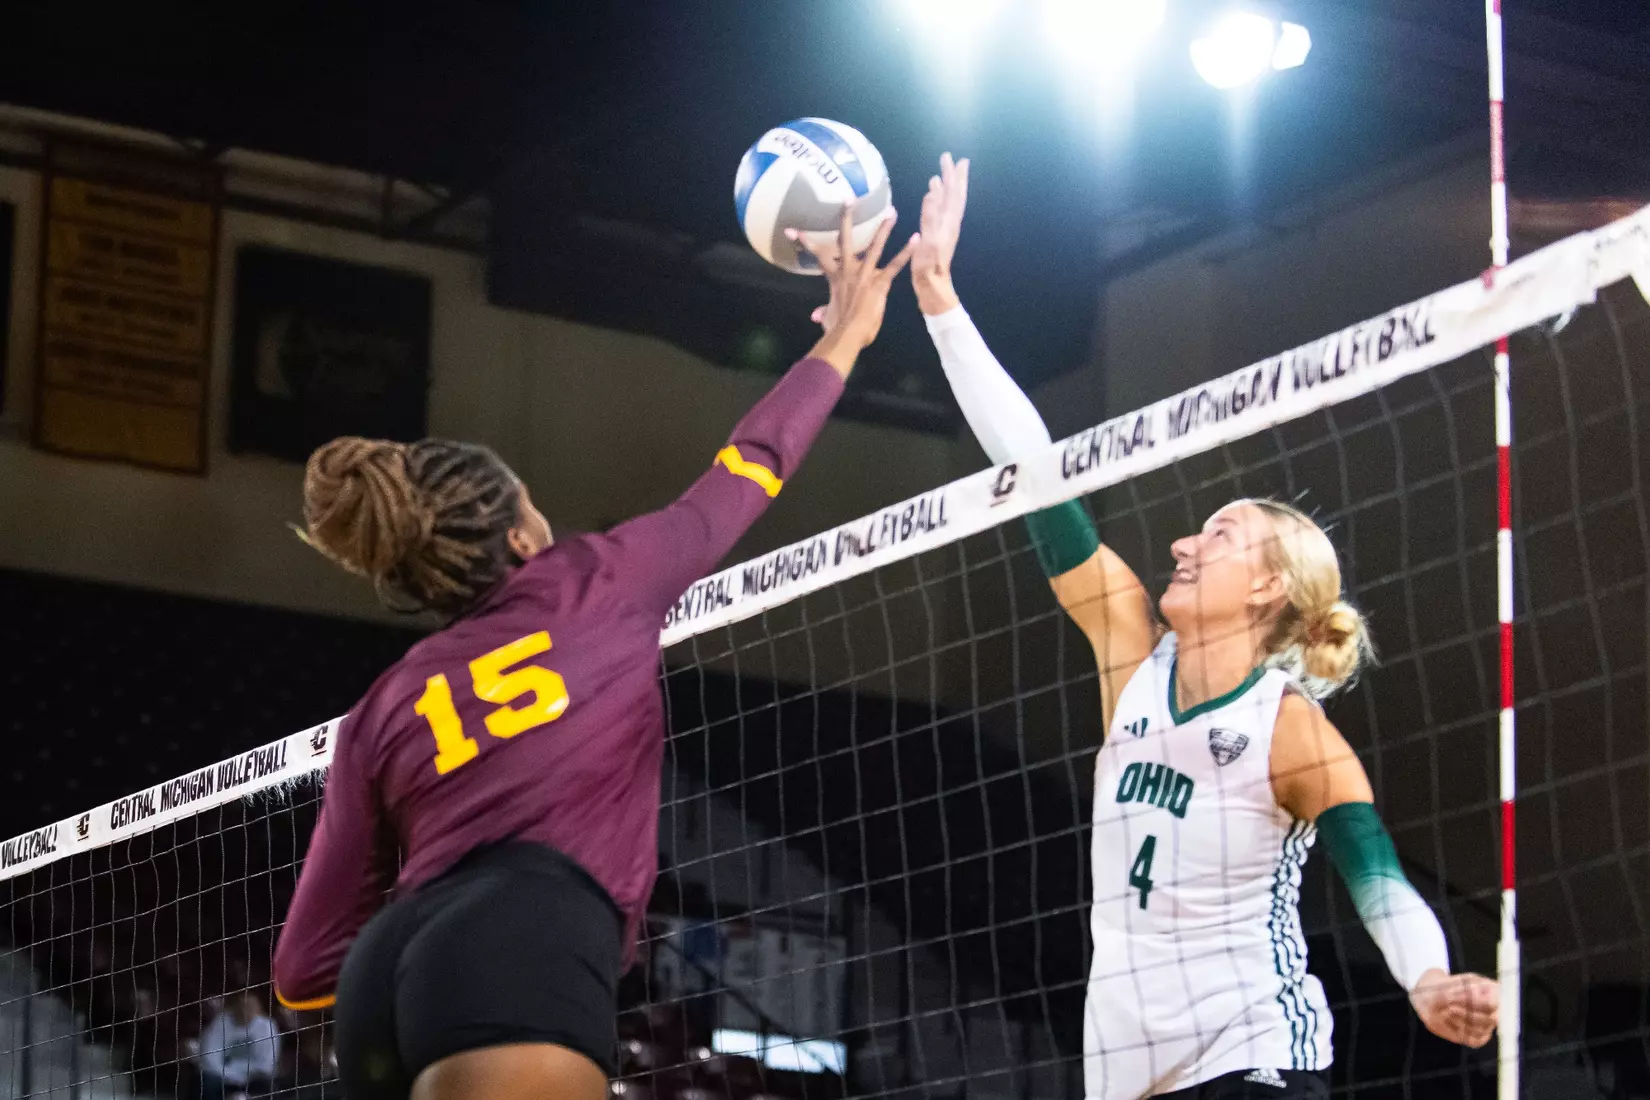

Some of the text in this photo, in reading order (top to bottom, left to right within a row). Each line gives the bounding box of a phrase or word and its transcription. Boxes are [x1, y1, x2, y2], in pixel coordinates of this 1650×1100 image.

[1062, 412, 1155, 480] CENTRAL
[742, 538, 827, 596] MICHIGAN
[414, 630, 570, 775] 15
[110, 740, 287, 830] CENTRAL MICHIGAN VOLLEYBALL
[1115, 761, 1195, 819] OHIO
[1, 824, 58, 870] VOLLEYBALL
[1129, 834, 1157, 910] 4
